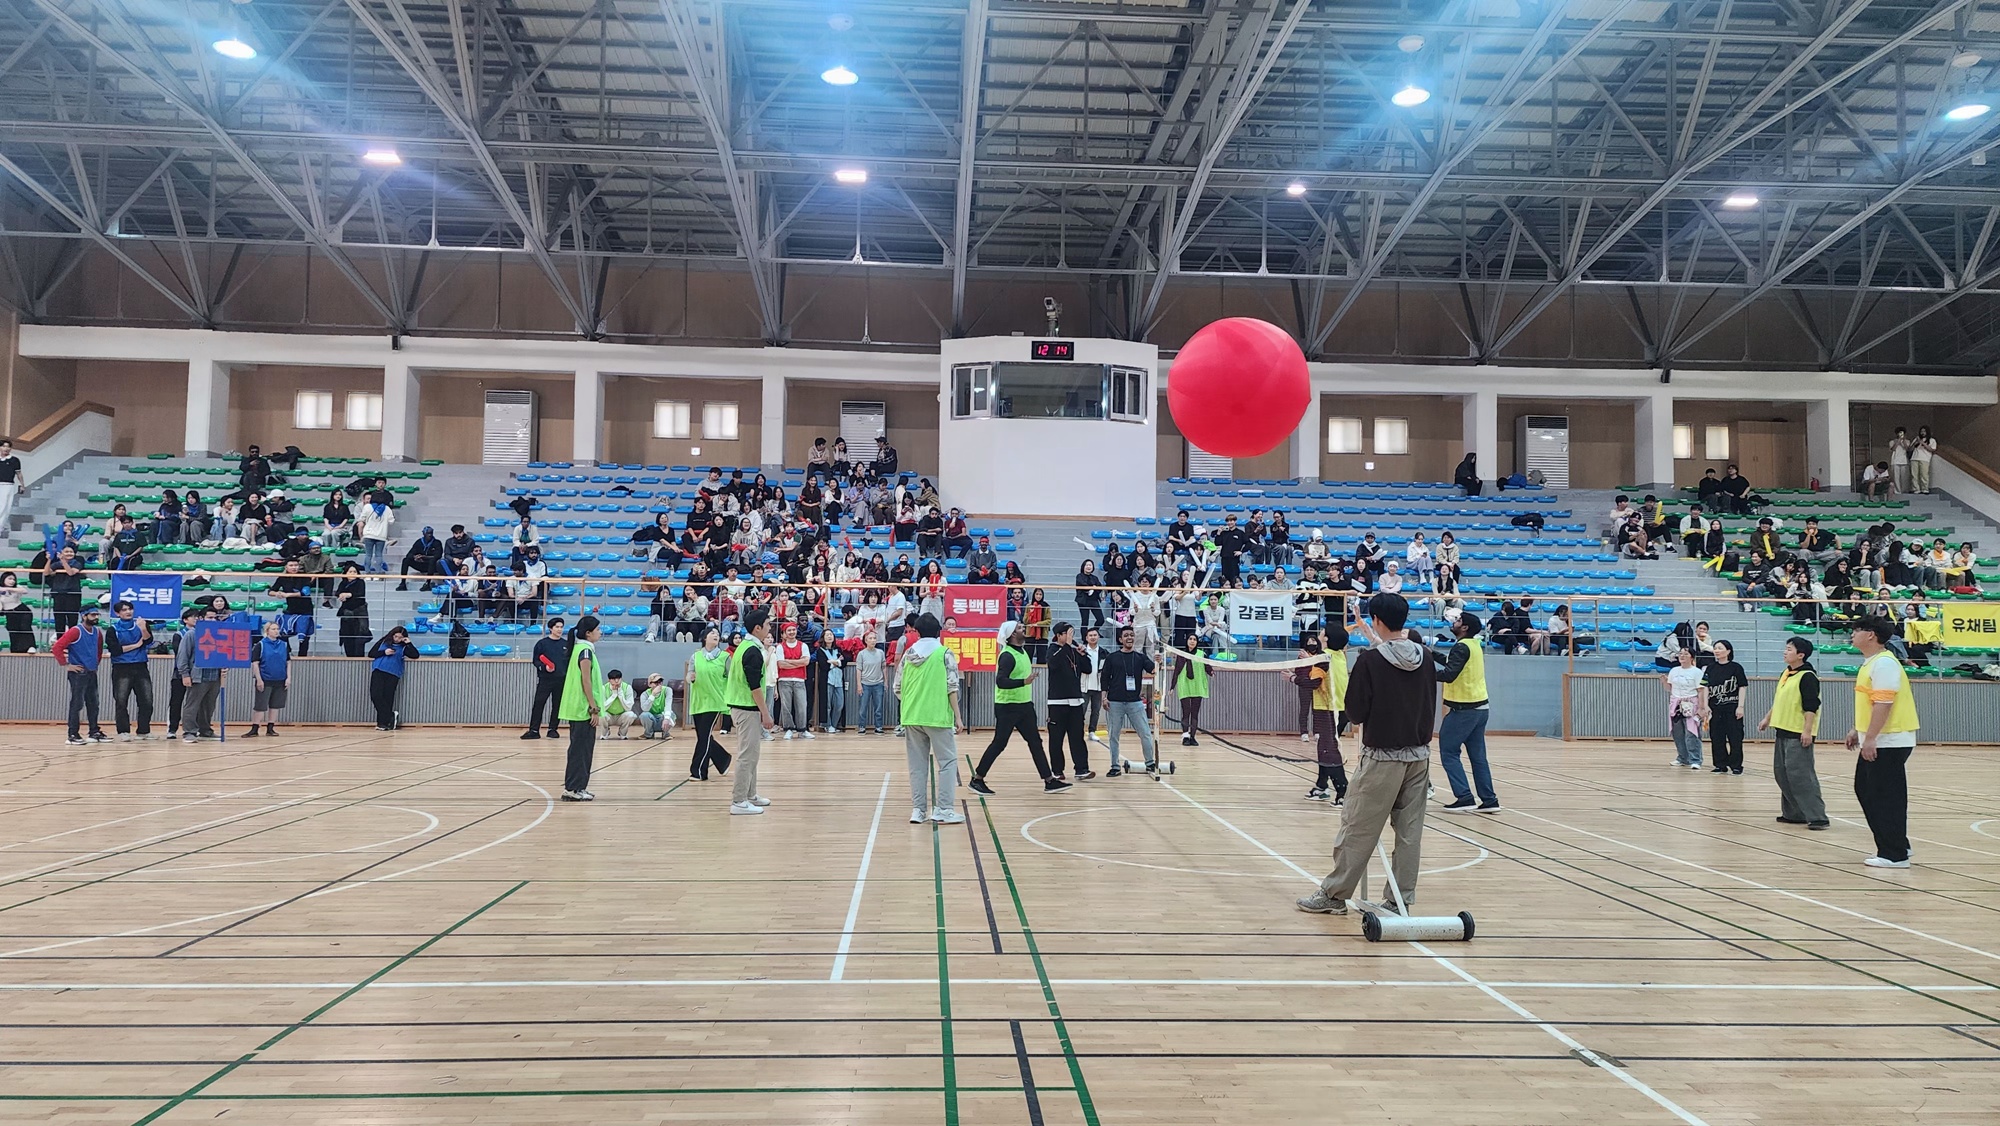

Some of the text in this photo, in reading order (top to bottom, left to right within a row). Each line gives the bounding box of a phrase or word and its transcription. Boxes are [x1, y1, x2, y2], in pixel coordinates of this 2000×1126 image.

[119, 587, 173, 605] 수국팀
[952, 598, 1000, 615] 동백팀
[1238, 605, 1285, 621] 감귤팀
[1951, 617, 1997, 633] 유채팀
[198, 628, 250, 661] 수국팀
